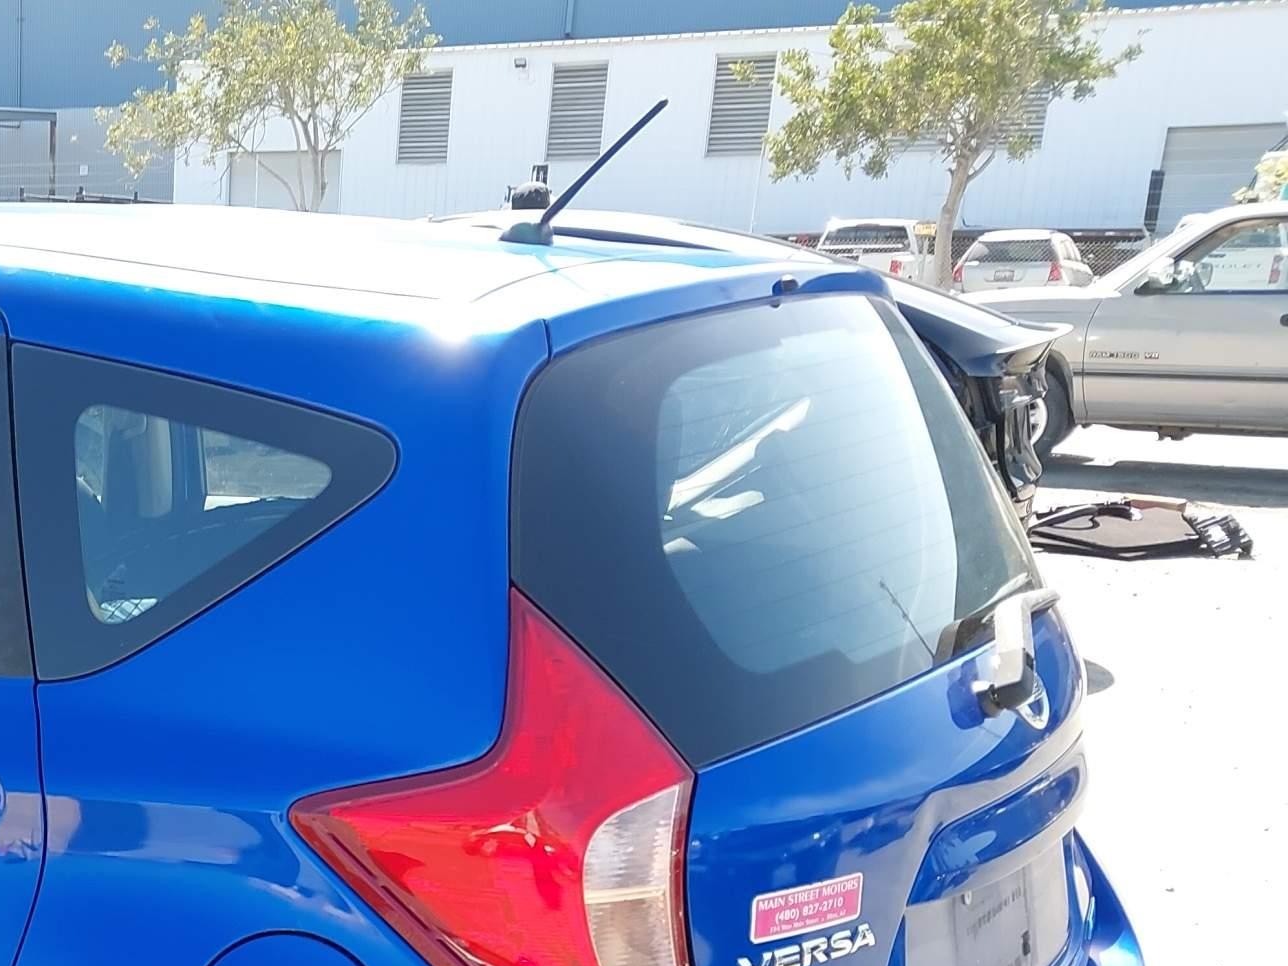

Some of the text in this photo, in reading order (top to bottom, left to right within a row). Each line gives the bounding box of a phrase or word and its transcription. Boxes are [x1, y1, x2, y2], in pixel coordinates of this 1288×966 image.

[758, 878, 859, 912] MAIN STREET MOTORS
[775, 897, 844, 924] (480) 827-2710
